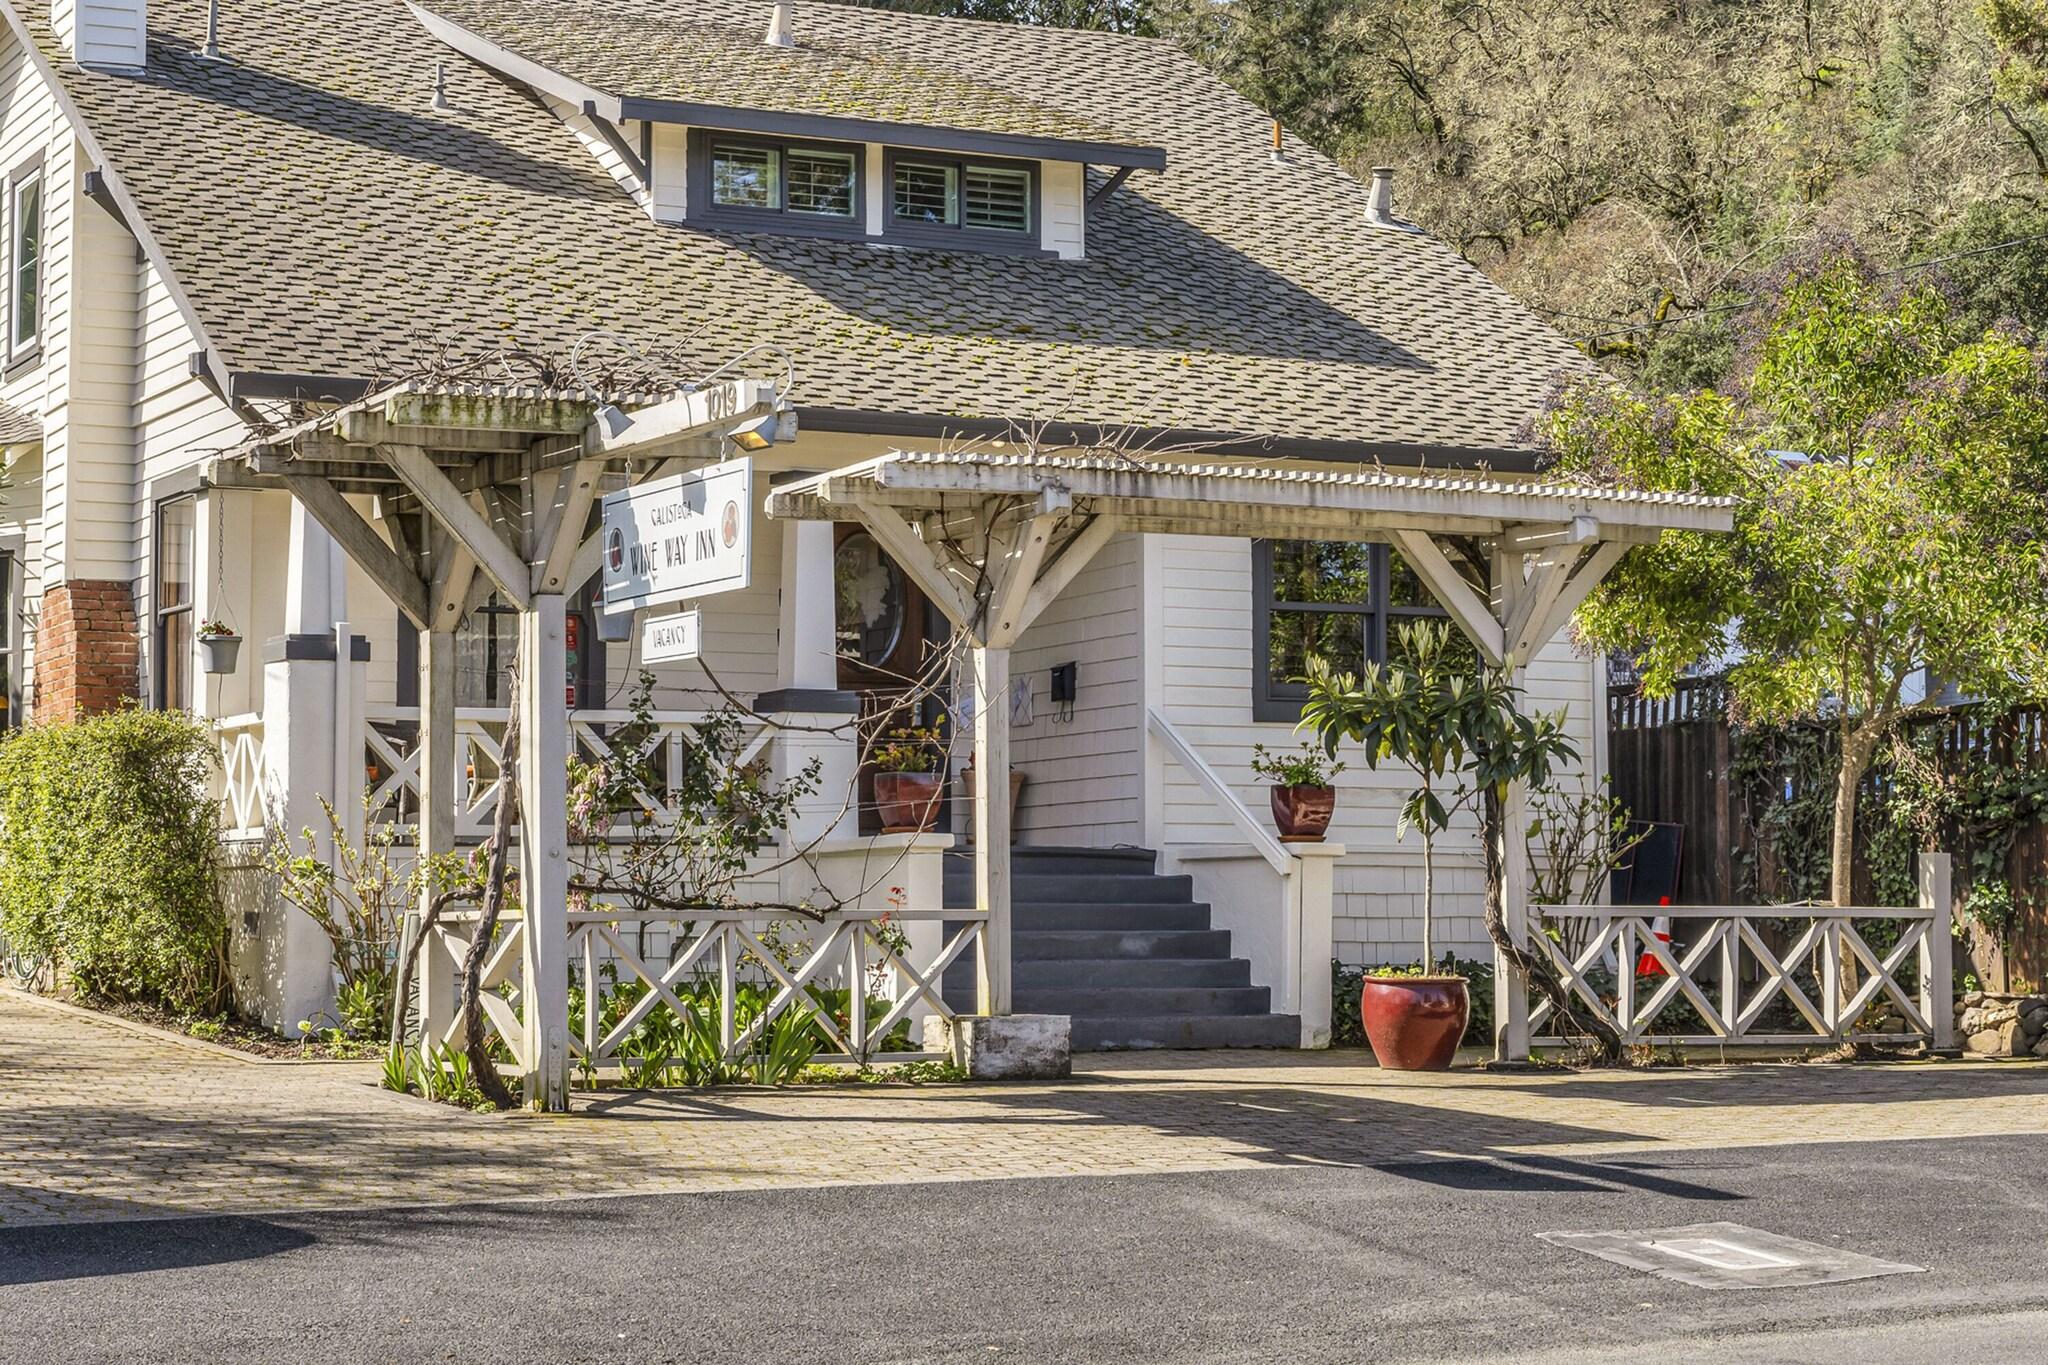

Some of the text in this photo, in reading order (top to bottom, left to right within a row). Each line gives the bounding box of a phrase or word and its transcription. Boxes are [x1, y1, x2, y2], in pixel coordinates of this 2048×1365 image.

[705, 384, 737, 420] 1019
[651, 500, 692, 528] CALISTOGA
[630, 528, 716, 576] WINE WAY INN
[652, 625, 688, 649] VACANCY
